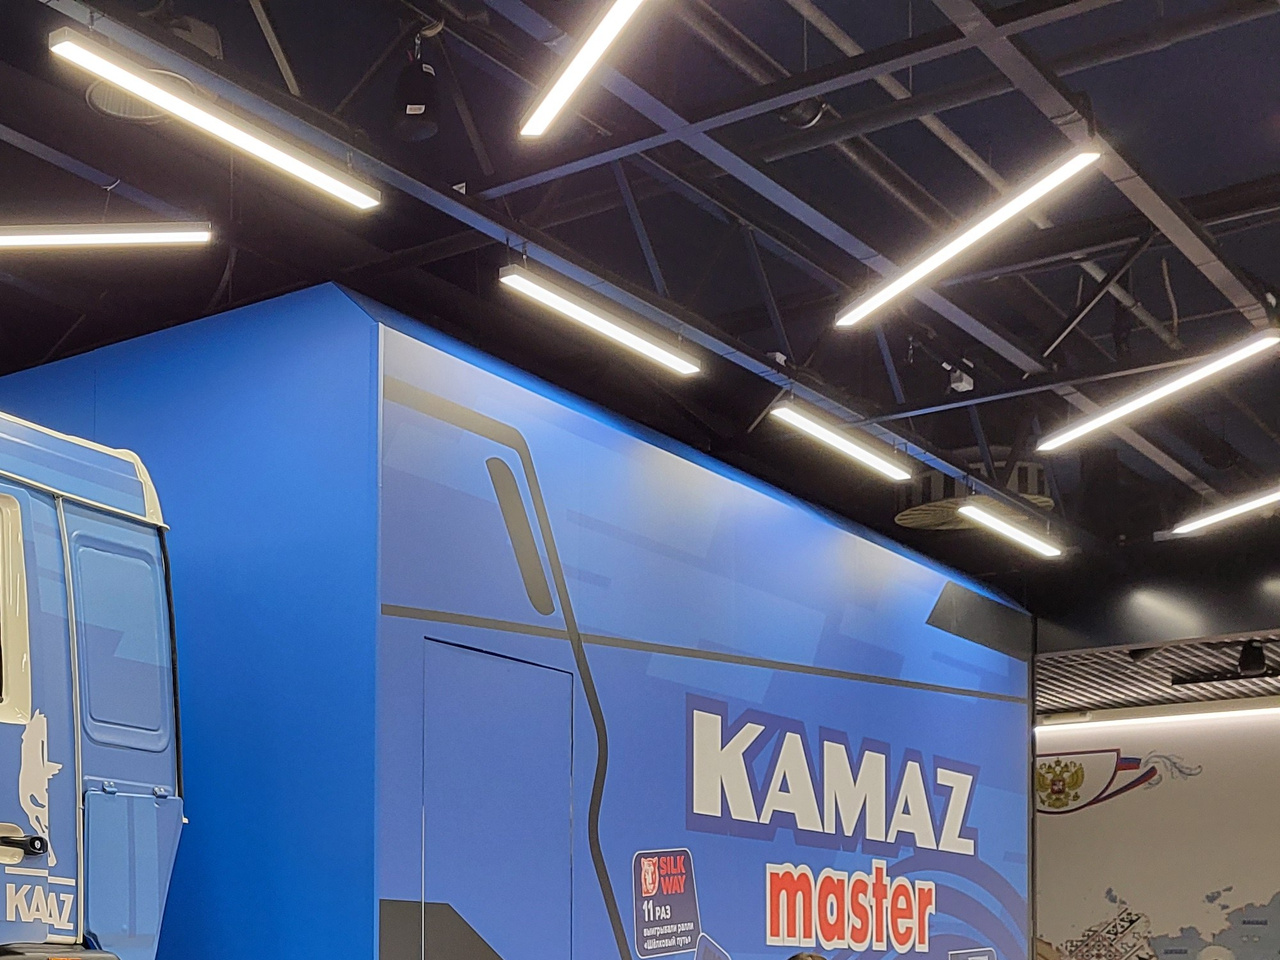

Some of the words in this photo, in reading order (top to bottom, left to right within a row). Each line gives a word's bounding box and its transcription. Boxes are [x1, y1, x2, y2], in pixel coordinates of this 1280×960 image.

[693, 709, 975, 856] KAMAZ
[659, 855, 685, 875] SILK
[660, 875, 685, 895] WAY
[642, 900, 654, 922] 11
[655, 905, 672, 920] РАЗ
[766, 860, 934, 952] master
